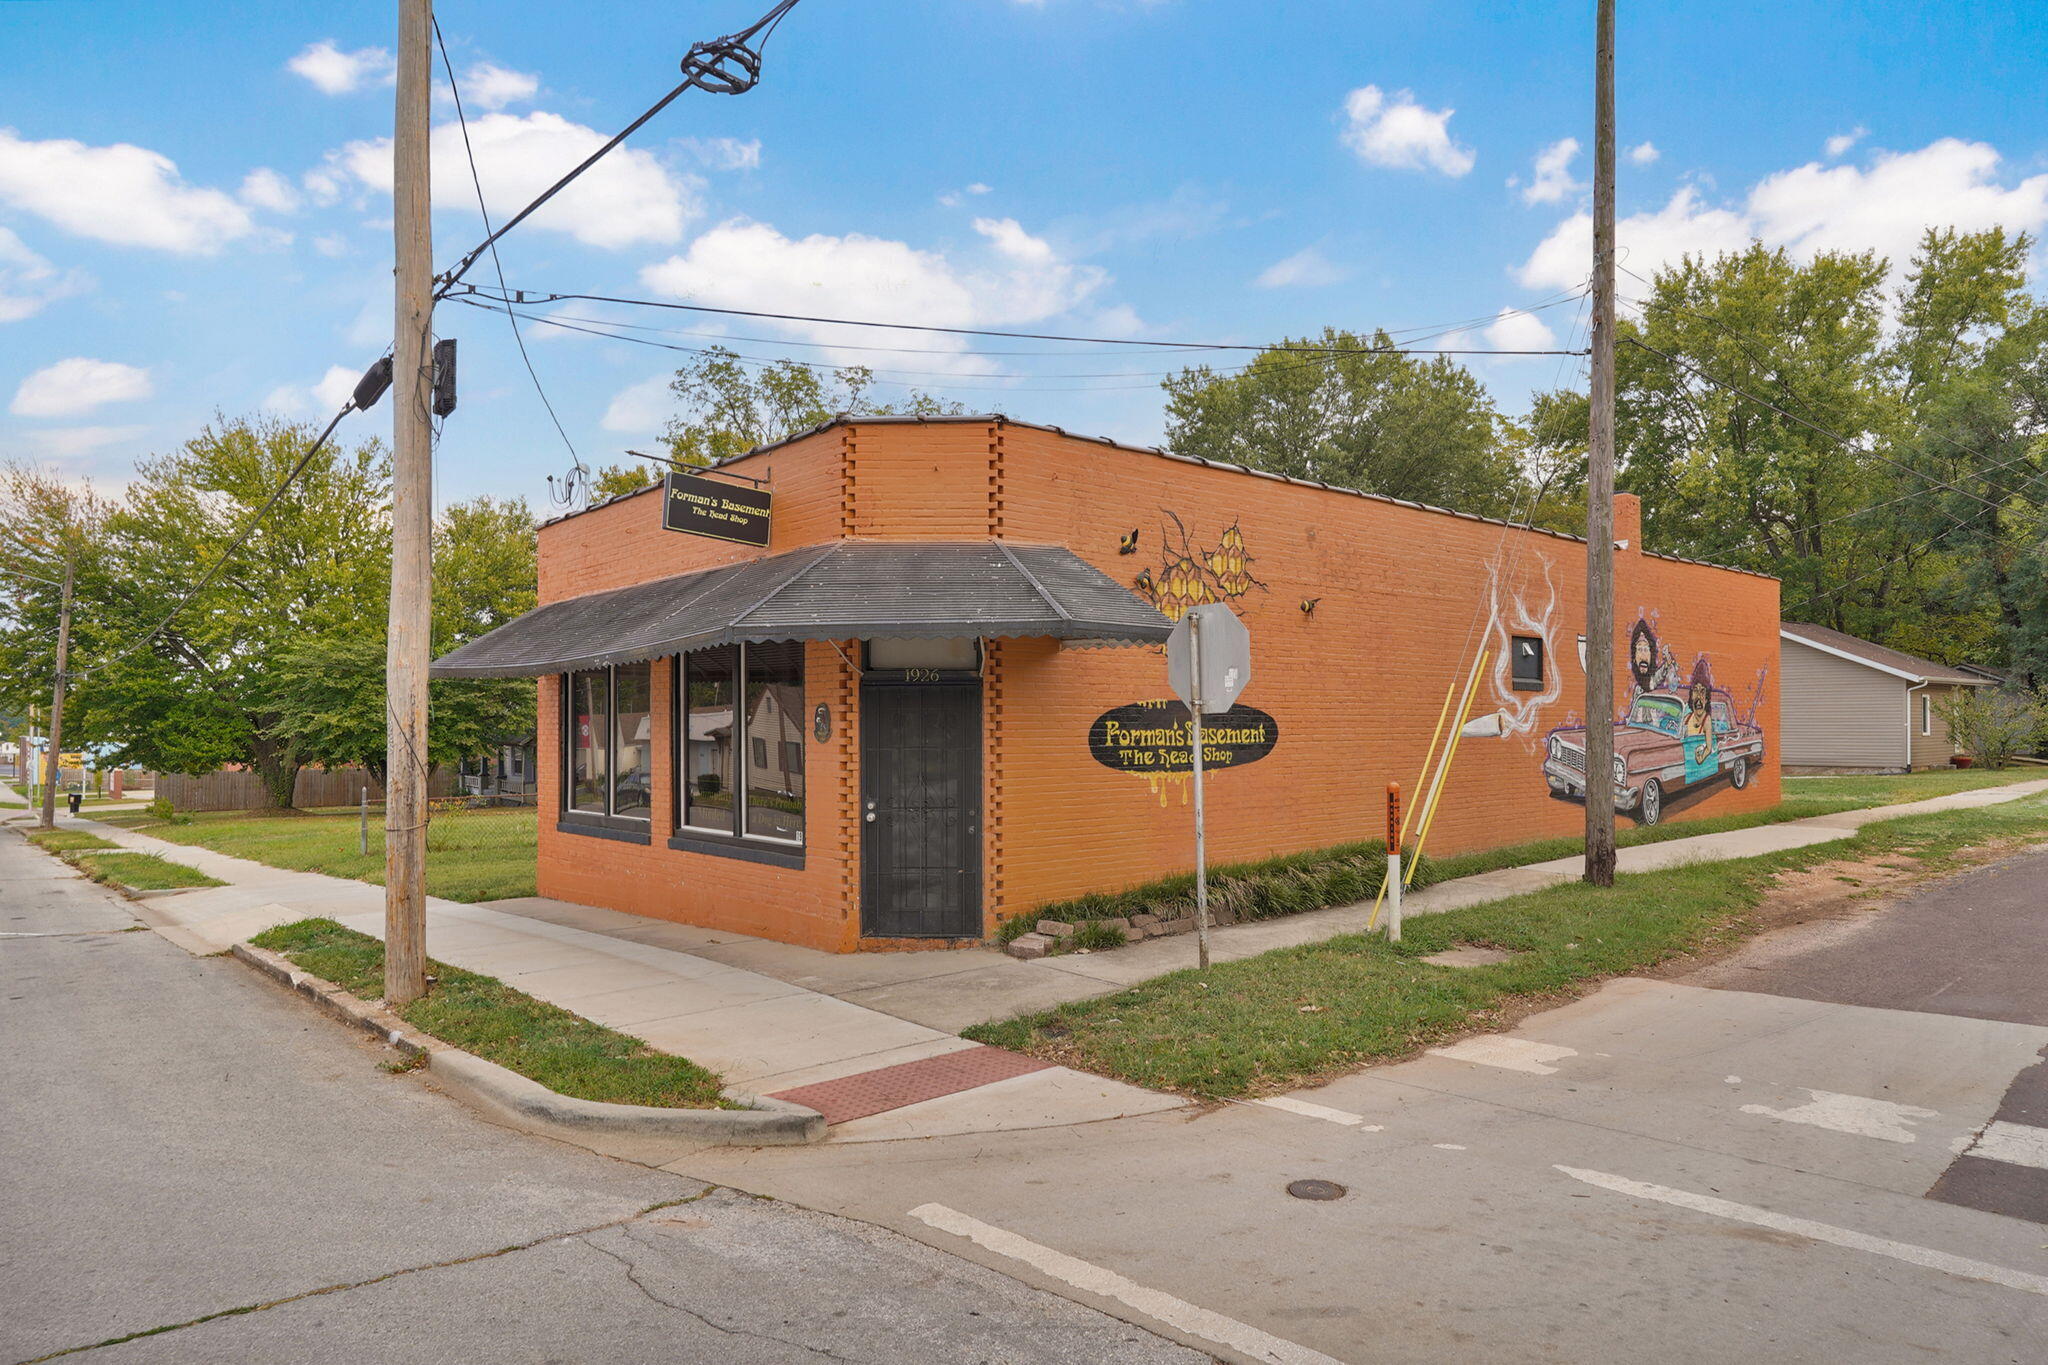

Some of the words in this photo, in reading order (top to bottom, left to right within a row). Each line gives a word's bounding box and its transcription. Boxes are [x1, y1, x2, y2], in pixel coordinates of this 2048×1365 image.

[670, 488, 718, 507] Forman's
[721, 498, 770, 517] Basement
[692, 506, 707, 516] The
[709, 509, 729, 520] Head
[730, 513, 748, 525] Shop
[904, 668, 939, 682] 1926
[1105, 717, 1185, 747] Forman's
[1119, 749, 1155, 765] The
[1203, 747, 1233, 764] Shop
